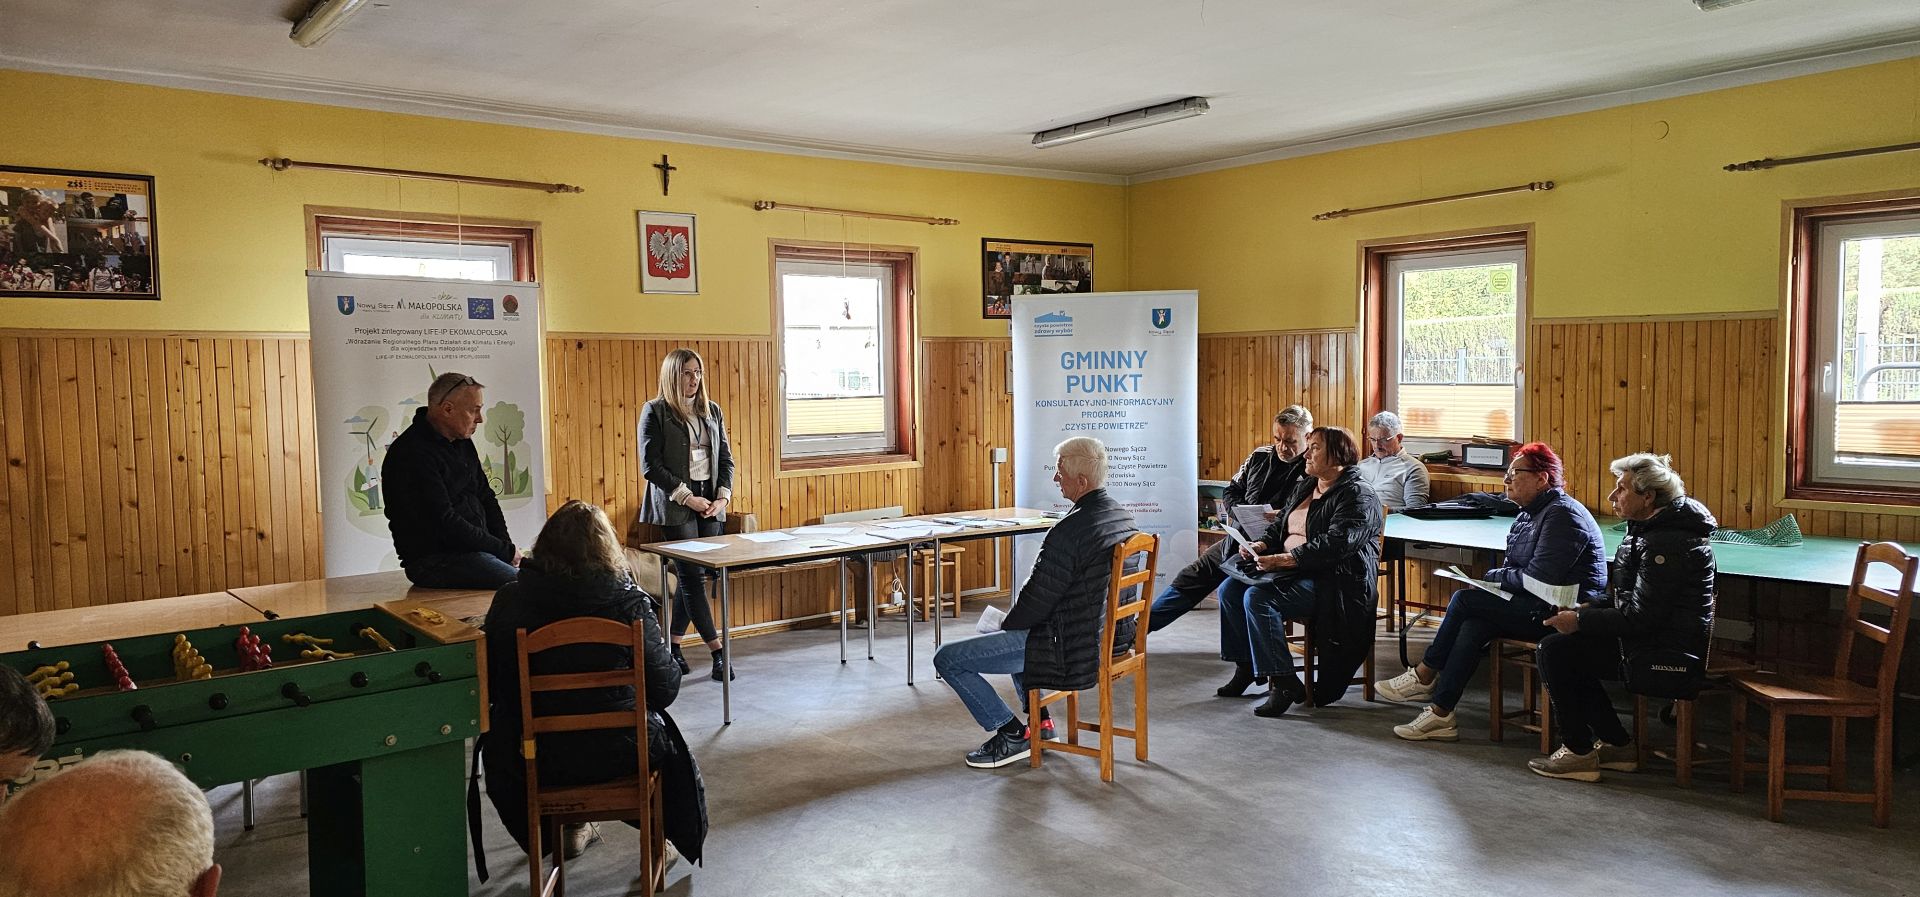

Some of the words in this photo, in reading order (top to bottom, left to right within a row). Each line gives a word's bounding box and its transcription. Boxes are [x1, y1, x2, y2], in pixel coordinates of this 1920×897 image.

[356, 302, 376, 310] Nowy
[408, 302, 463, 312] MAŁOPOLSKA
[354, 327, 380, 336] Projekt
[382, 328, 423, 337] zintegrowany
[424, 328, 448, 336] LIFE-IP
[1060, 350, 1148, 370] GMINNY
[1066, 374, 1143, 394] PUNKT
[1035, 398, 1175, 408] KONSULTACYJNO-INFORMACYJNY
[1081, 410, 1127, 419] PROGRAMU
[1130, 445, 1147, 453] Sącza
[1132, 454, 1146, 462] Sącz
[1117, 463, 1137, 471] Czyste
[1137, 462, 1168, 470] Powietrze
[1142, 480, 1156, 488] Sącz
